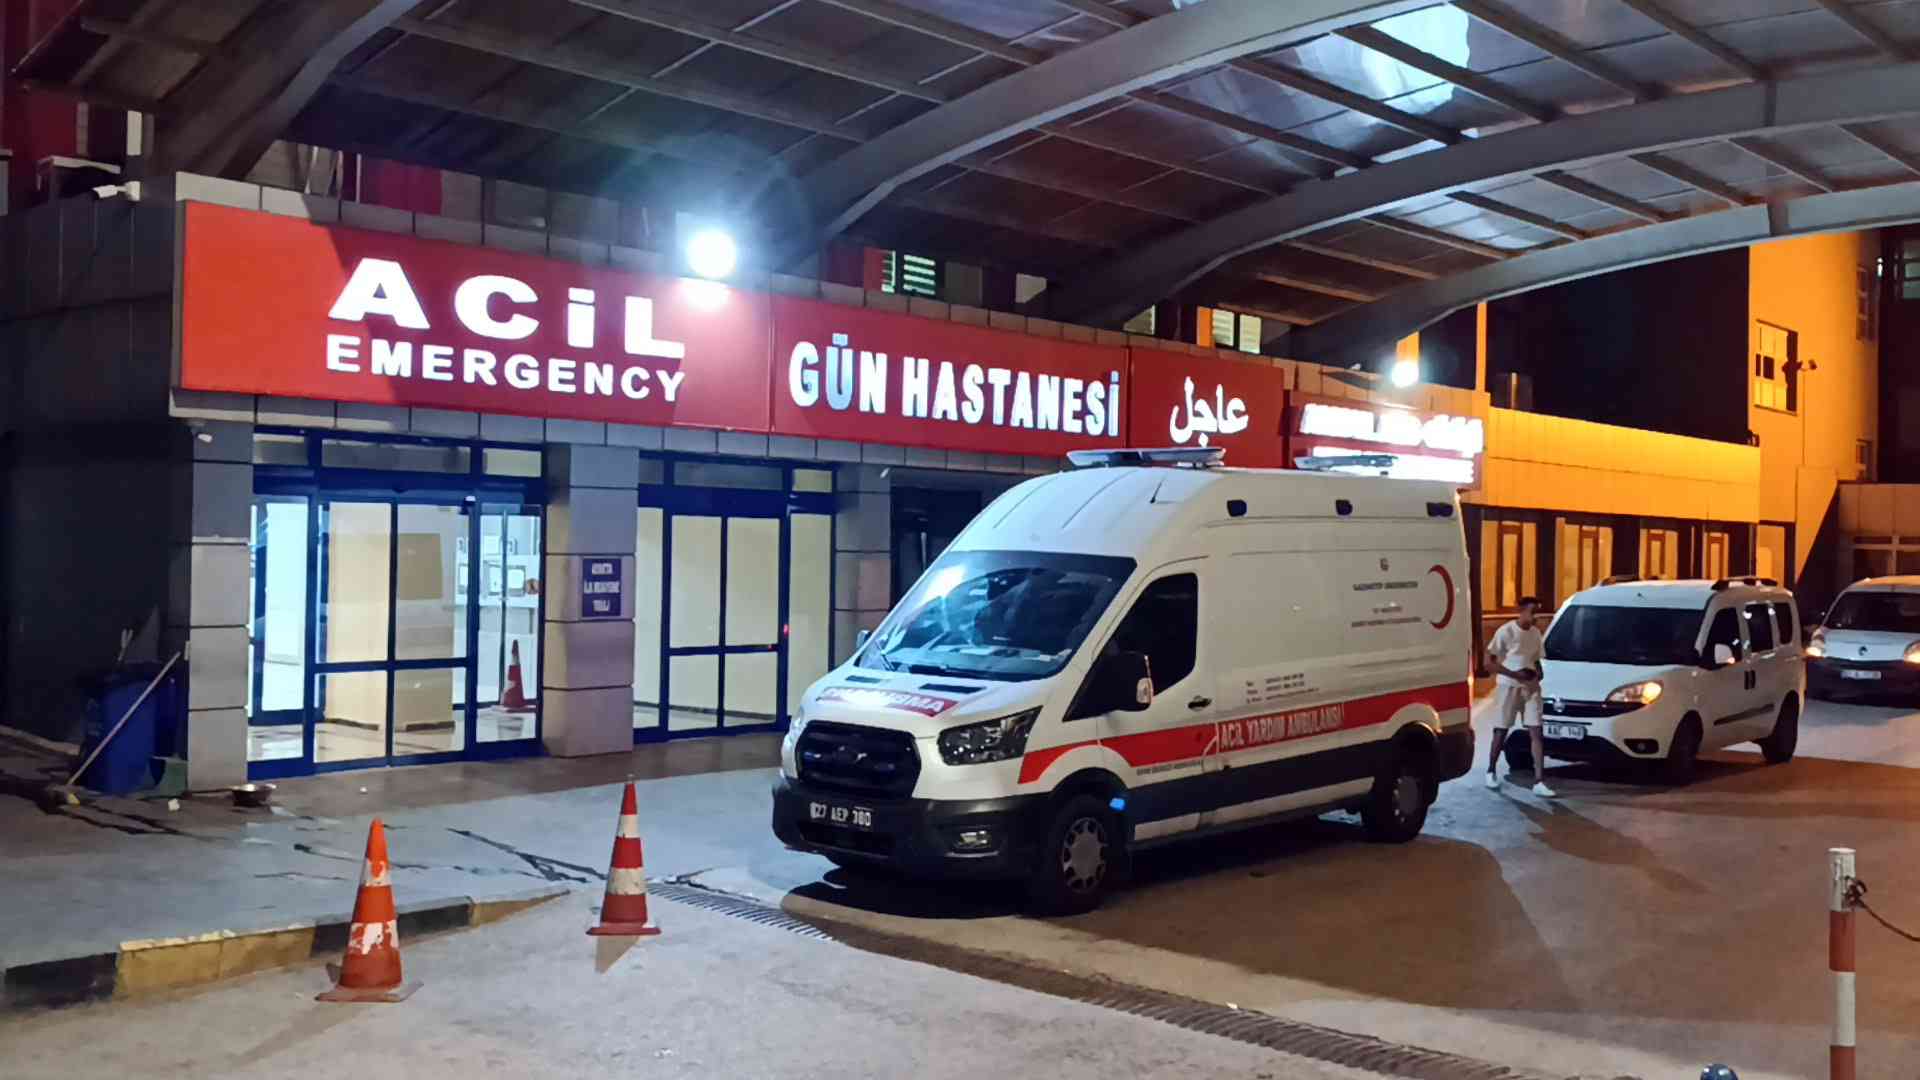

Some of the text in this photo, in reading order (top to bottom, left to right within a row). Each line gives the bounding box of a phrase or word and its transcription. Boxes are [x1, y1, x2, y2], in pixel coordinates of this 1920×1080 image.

[326, 334, 687, 403] EMERGENCY
[788, 332, 888, 414] GÜN
[1169, 376, 1249, 448] عاجل
